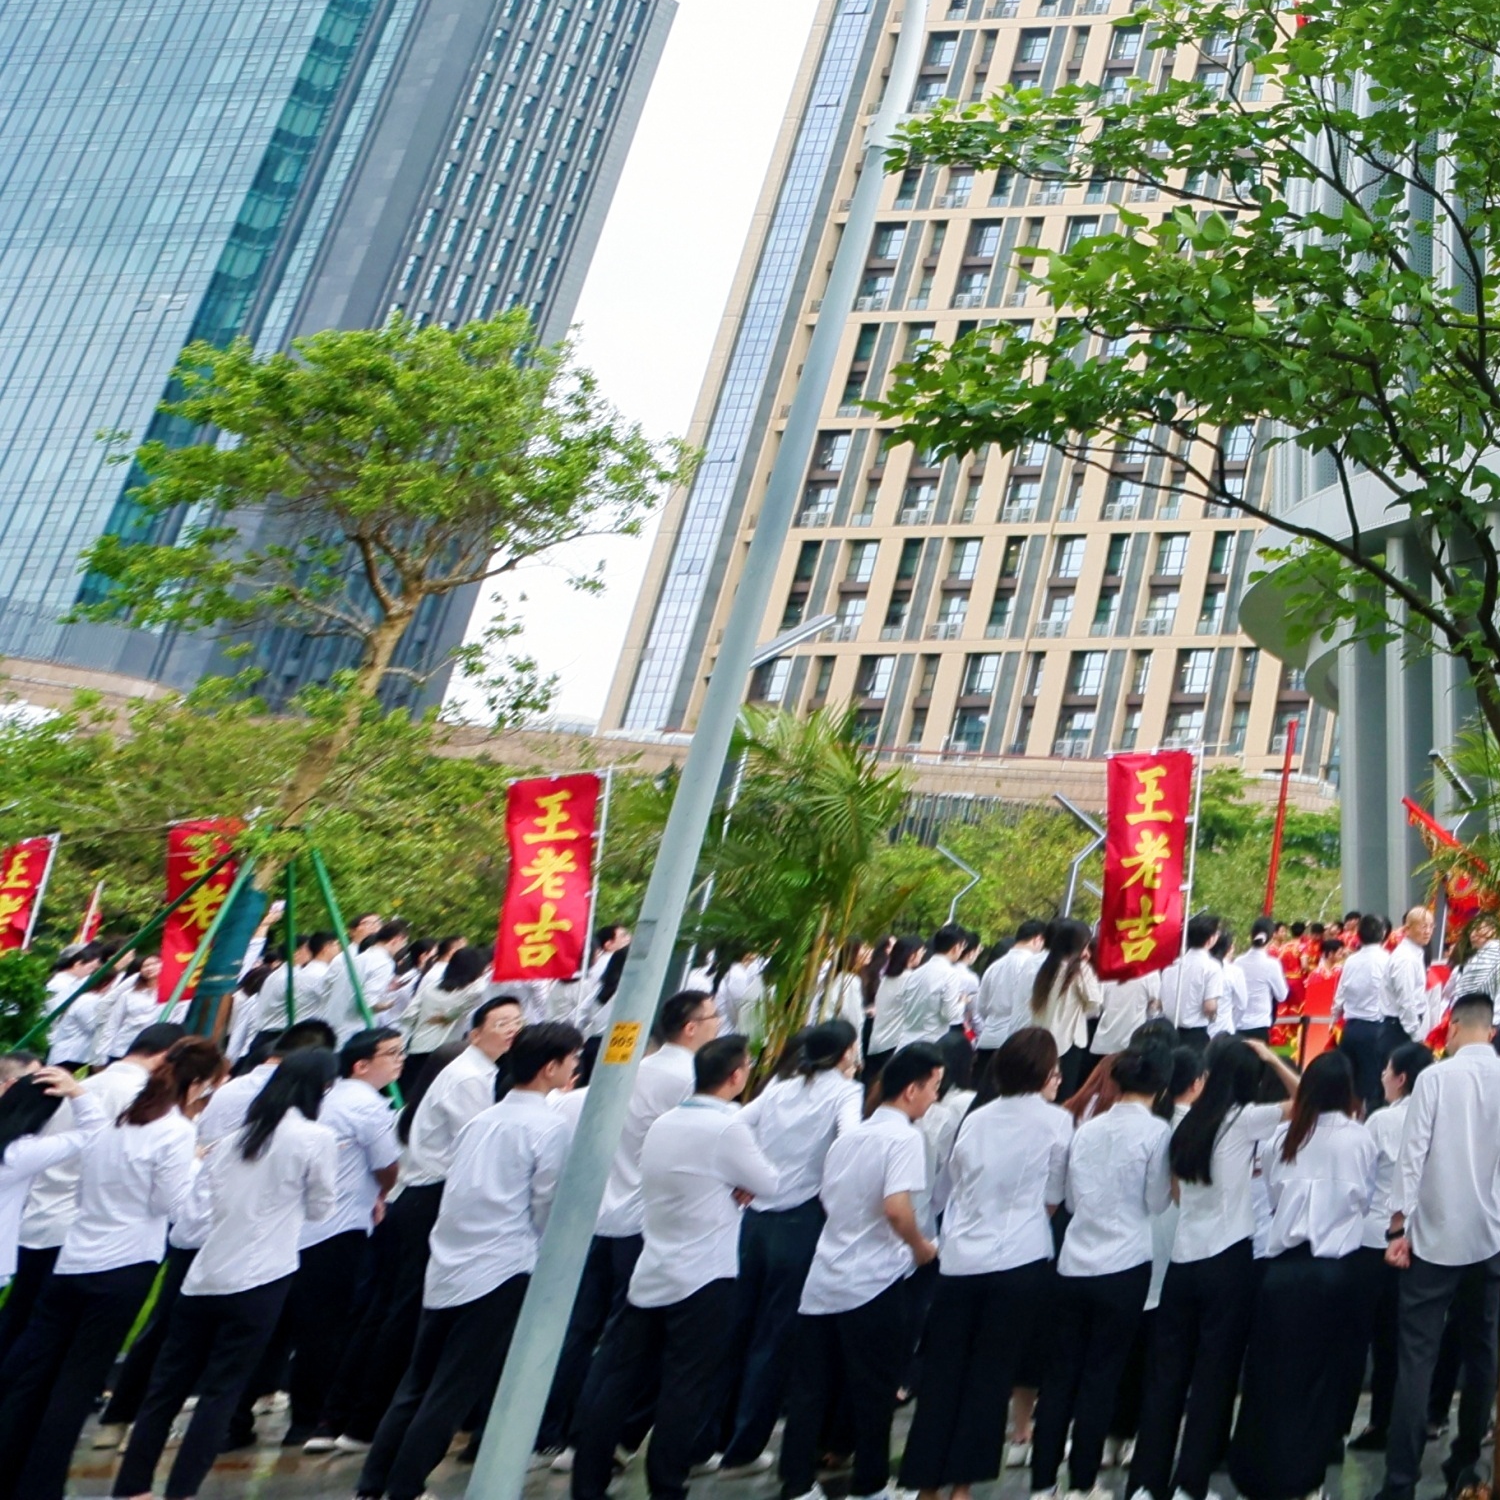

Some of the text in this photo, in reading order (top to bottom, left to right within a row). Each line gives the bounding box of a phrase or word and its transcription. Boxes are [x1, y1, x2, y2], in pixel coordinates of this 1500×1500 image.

[0, 851, 32, 936] 王老
[509, 788, 580, 968] 王老吉
[1115, 764, 1174, 965] 王老吉
